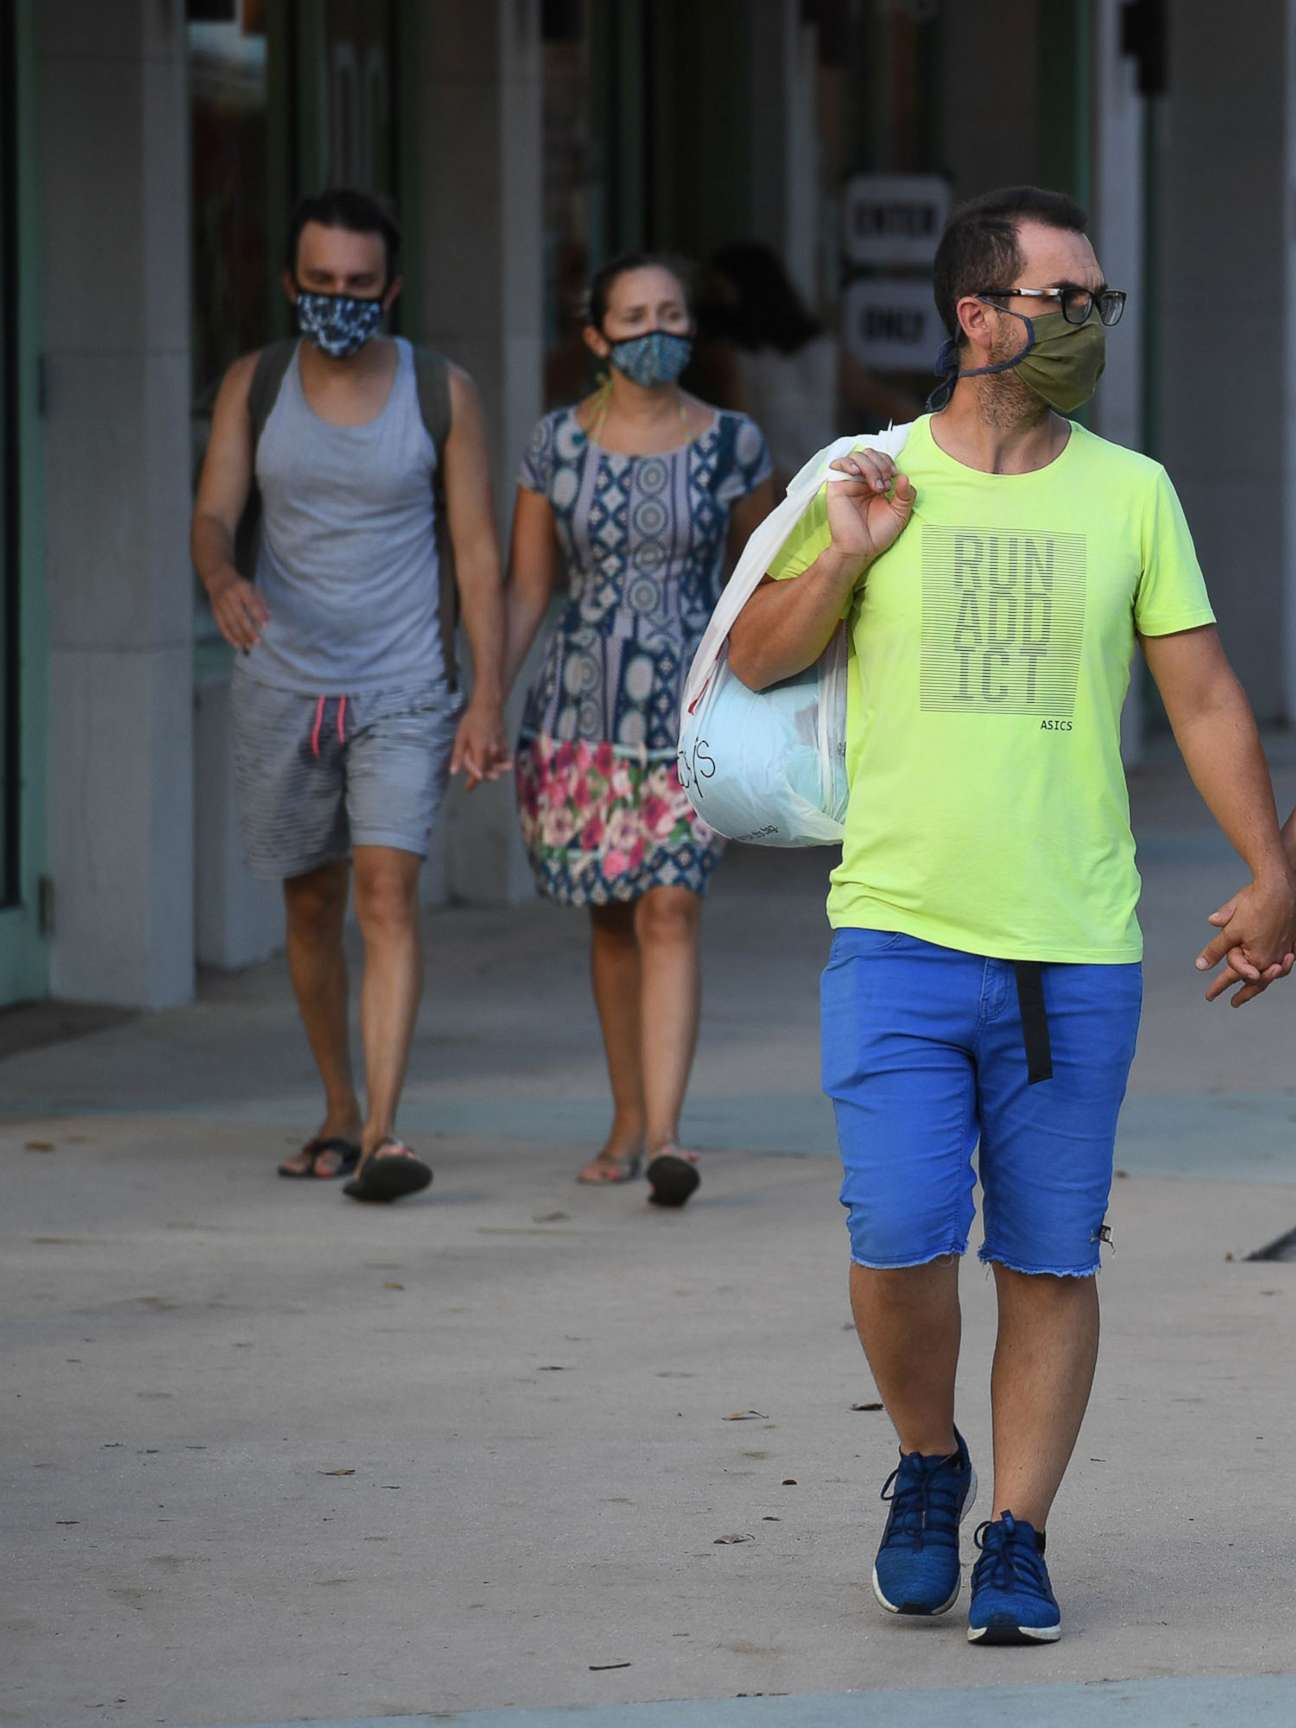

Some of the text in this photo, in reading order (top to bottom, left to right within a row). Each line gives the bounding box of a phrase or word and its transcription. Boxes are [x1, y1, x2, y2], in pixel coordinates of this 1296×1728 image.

[855, 202, 939, 237] ENTER
[863, 307, 926, 345] ONLY
[954, 534, 1055, 593] RUN
[953, 590, 1052, 646] ADD
[952, 647, 1048, 704] ICT
[1040, 719, 1073, 732] ASICS
